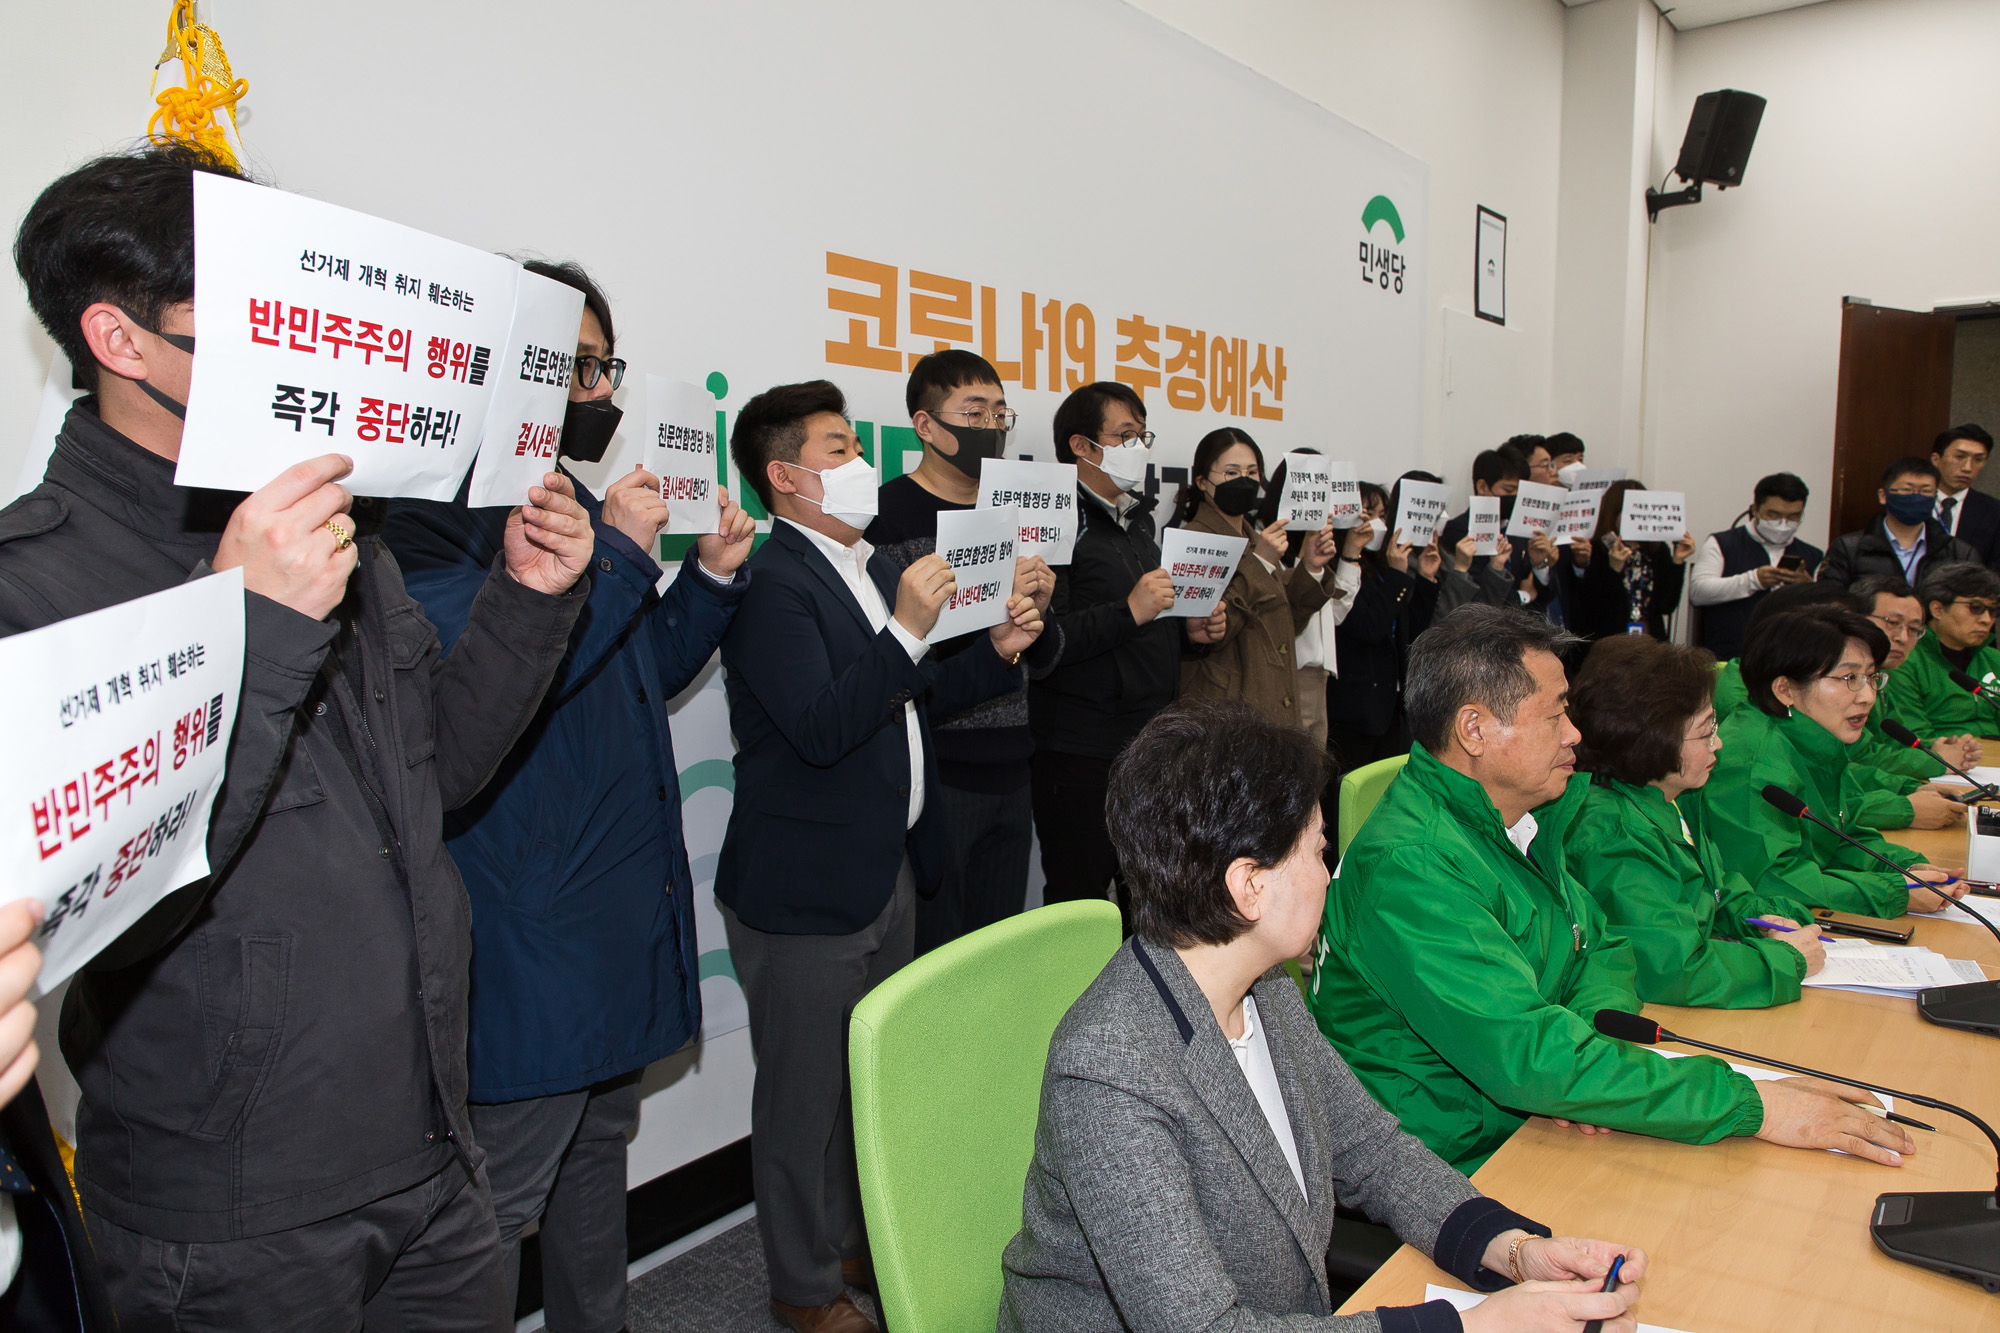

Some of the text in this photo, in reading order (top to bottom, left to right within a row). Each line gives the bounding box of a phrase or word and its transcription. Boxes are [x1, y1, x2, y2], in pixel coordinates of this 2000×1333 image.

[300, 249, 475, 313] 선거제 개혁 취지 훼손하는
[1359, 241, 1406, 294] 민생당
[249, 297, 492, 386] 반민주주의 행위를
[825, 250, 1287, 422] 코로나19 추경예산
[271, 383, 462, 449] 즉각 중단하라!
[658, 422, 704, 454] 친문연합정당
[662, 475, 710, 502] 결사반대한다!
[1055, 493, 1072, 510] 참여
[946, 539, 1014, 569] 친문연합정당 참여
[1171, 562, 1230, 579] 반민주주의 행위를
[949, 581, 1001, 610] 결사반대한다!
[59, 642, 205, 730] 선거제 개혁 취지 훼손하는
[31, 692, 224, 862] 반민주주의 행위를
[103, 788, 198, 899] 중단하라!
